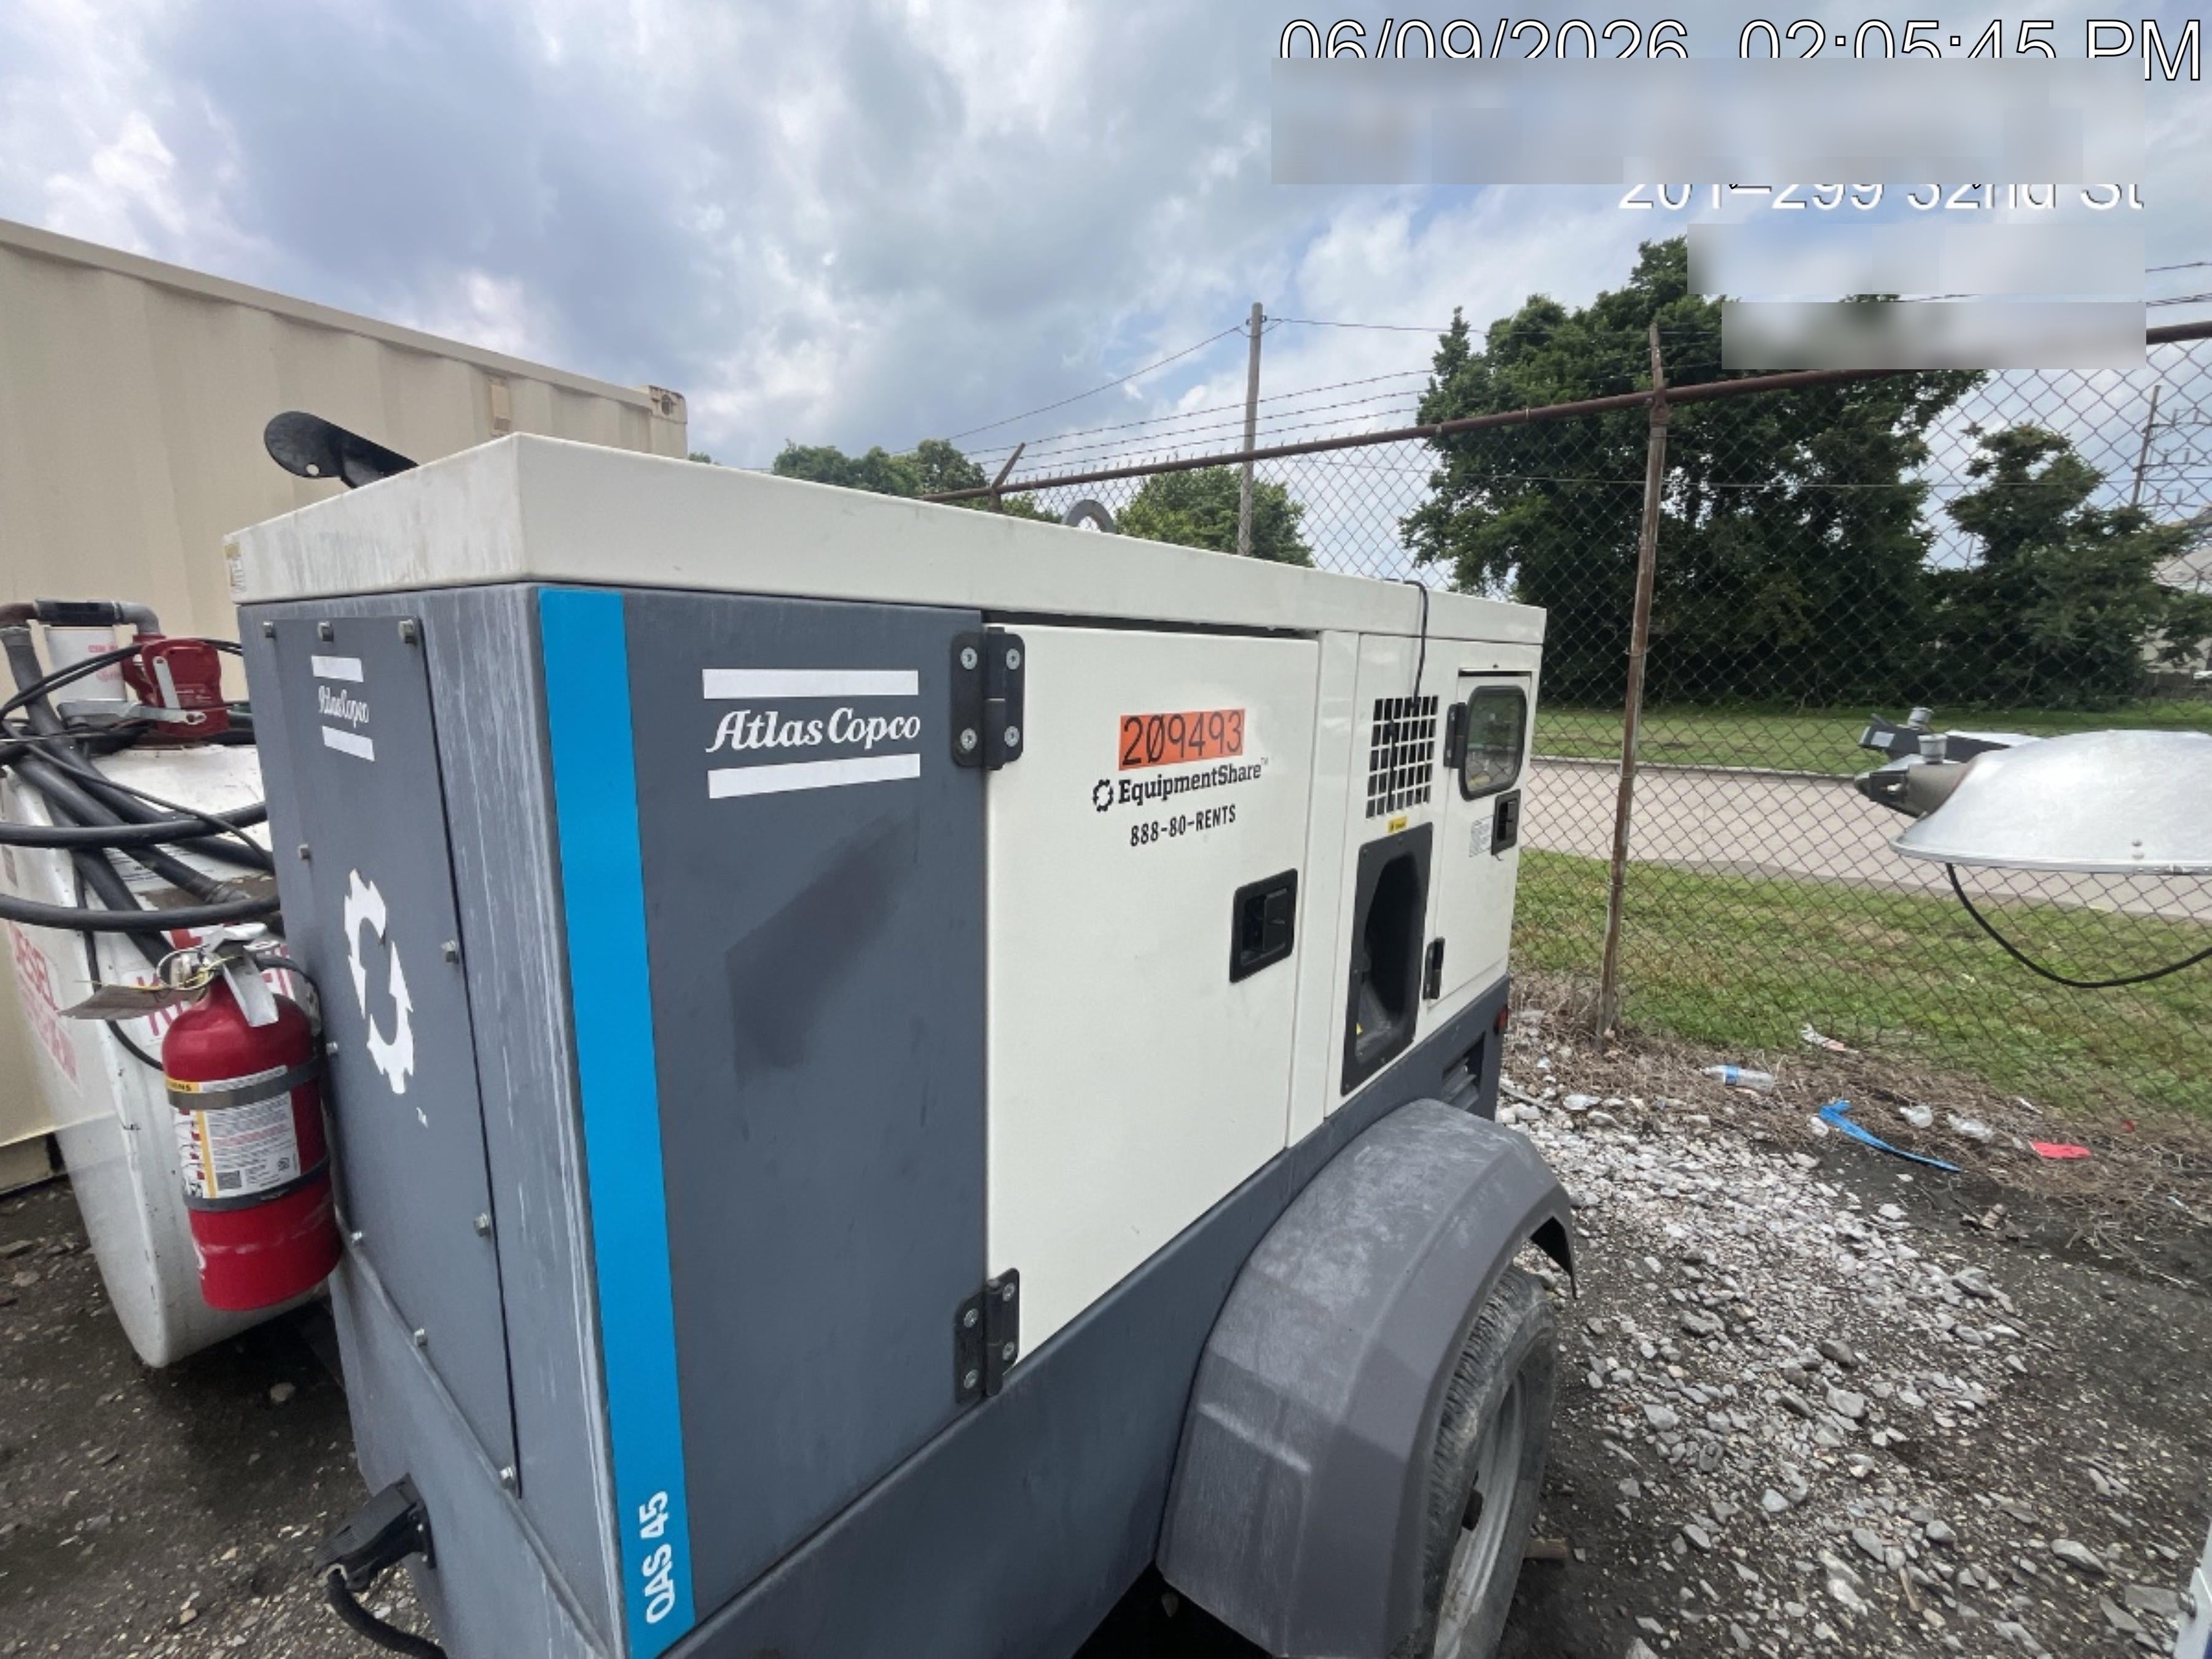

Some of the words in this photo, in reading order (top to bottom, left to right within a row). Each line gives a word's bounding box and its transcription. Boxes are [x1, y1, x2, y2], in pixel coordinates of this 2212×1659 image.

[705, 709, 823, 753] Atlas
[828, 707, 920, 750] Copco
[1122, 709, 1243, 766] 209493
[1118, 763, 1261, 806] EquipmentShare
[1130, 803, 1236, 847] 888-80-RENTS
[638, 1490, 670, 1540] 45
[641, 1543, 675, 1624] QAS
